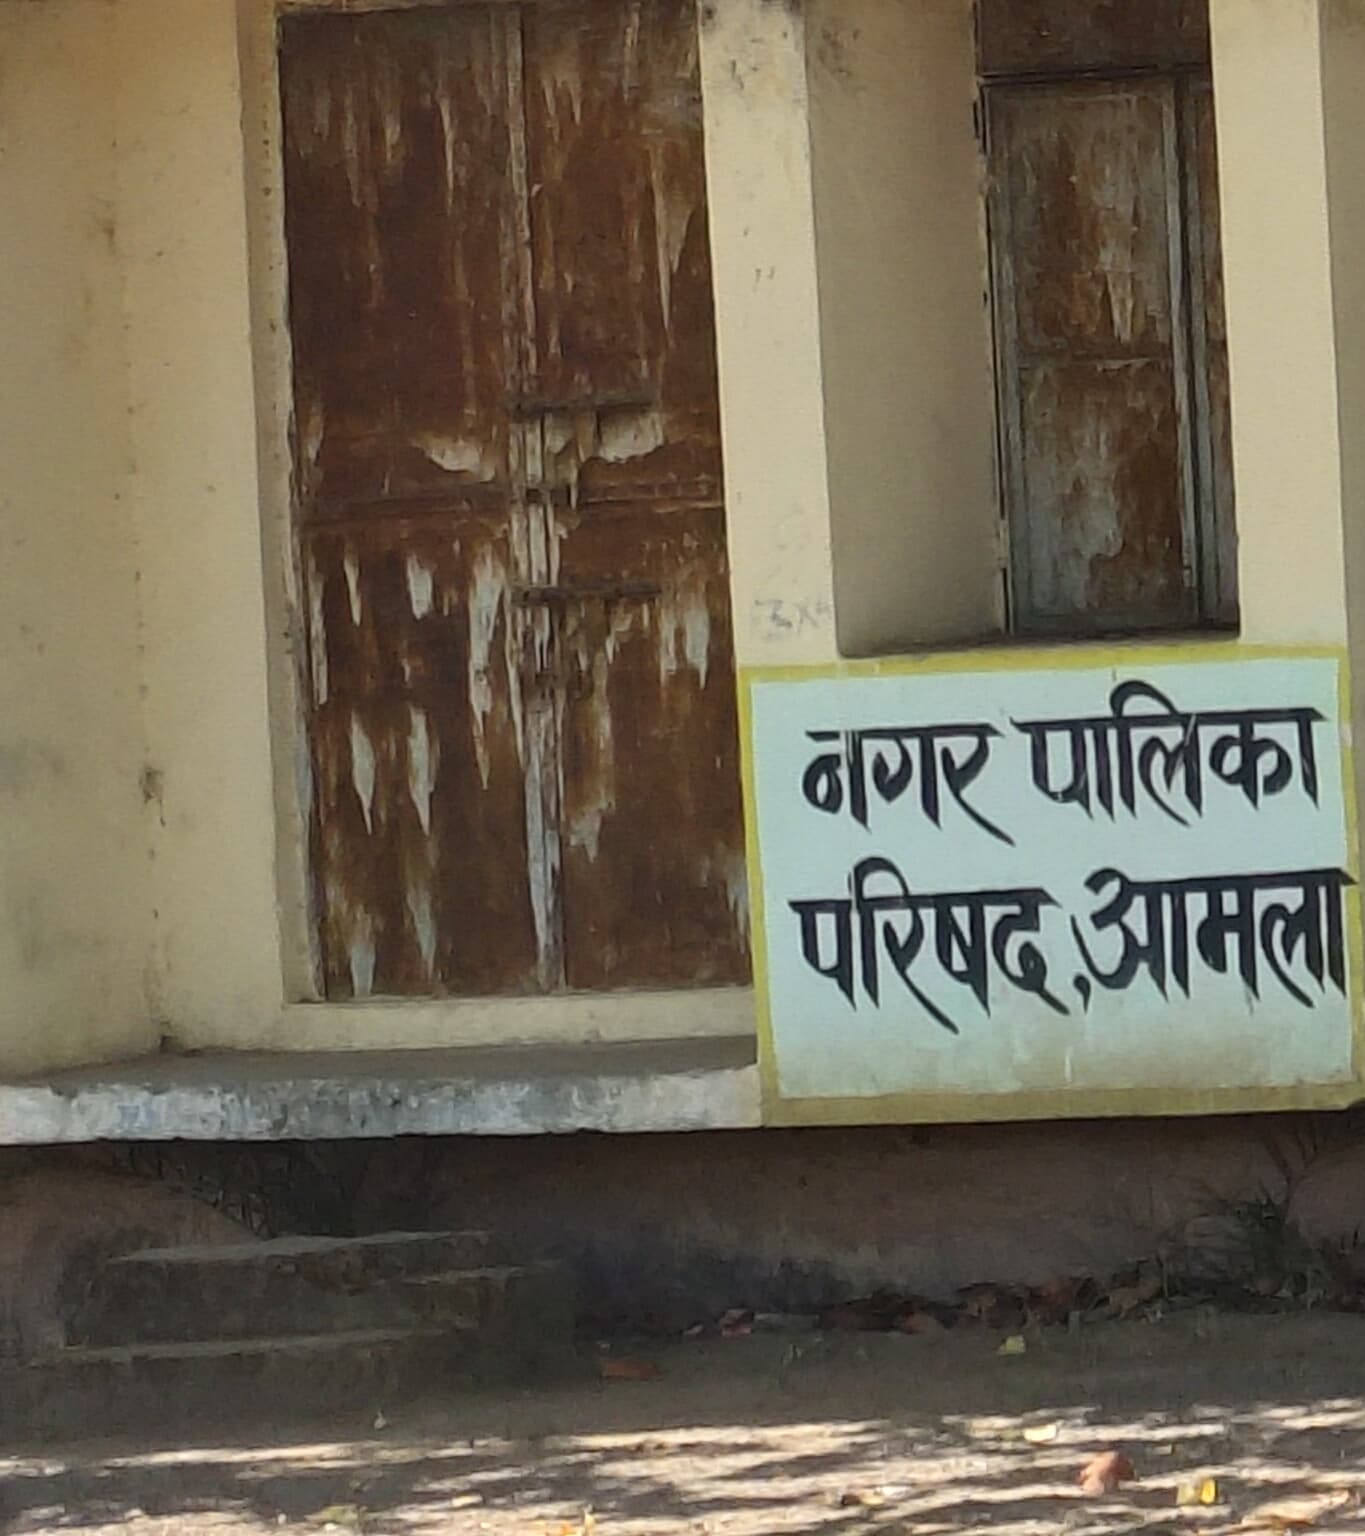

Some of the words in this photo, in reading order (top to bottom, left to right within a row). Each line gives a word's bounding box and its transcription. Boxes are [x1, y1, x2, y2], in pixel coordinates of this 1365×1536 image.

[802, 722, 1015, 846] नगर
[1010, 679, 1326, 827] पालिका
[1071, 867, 1357, 1009] आमला
